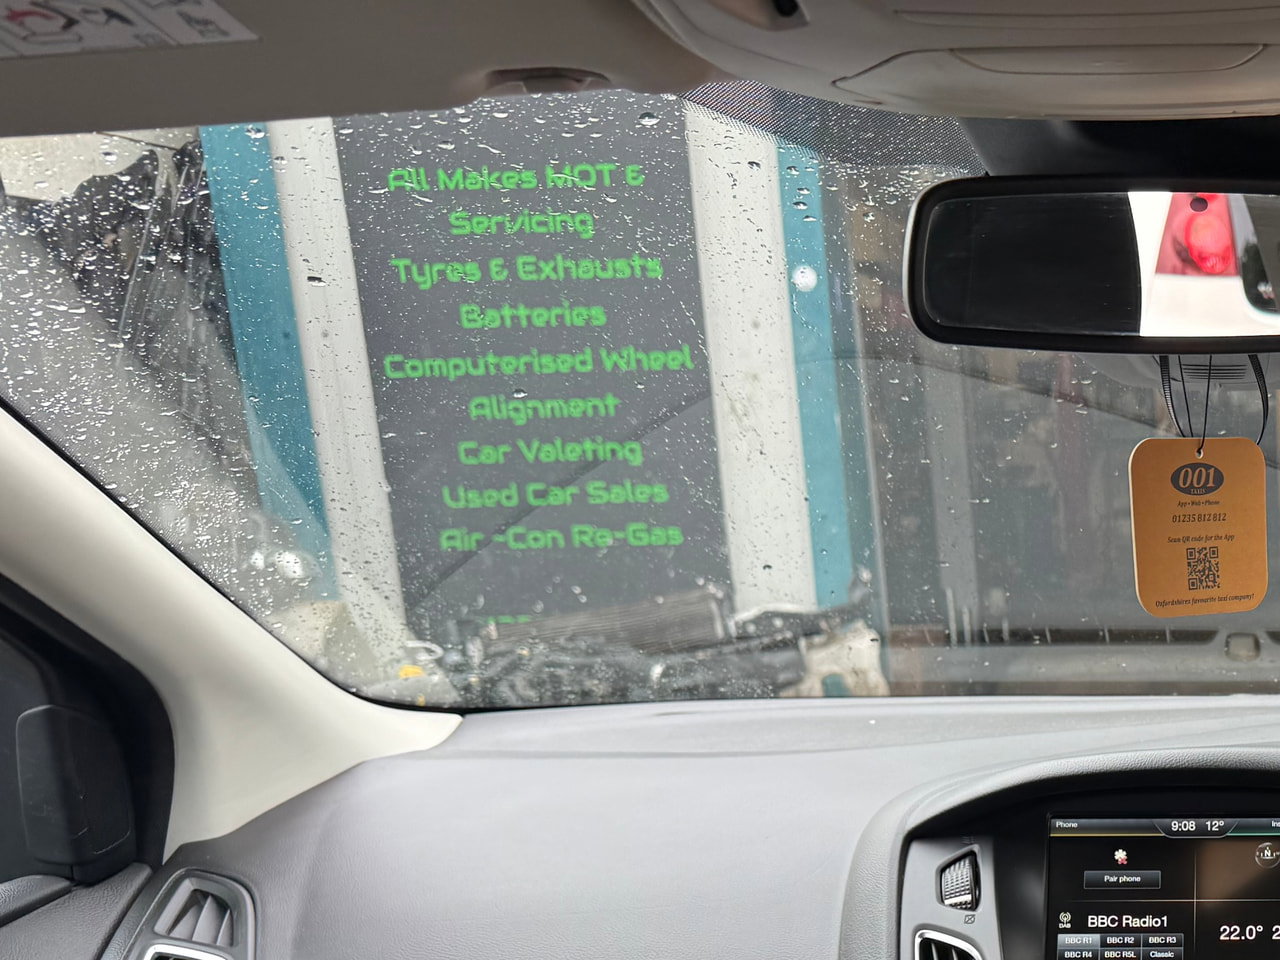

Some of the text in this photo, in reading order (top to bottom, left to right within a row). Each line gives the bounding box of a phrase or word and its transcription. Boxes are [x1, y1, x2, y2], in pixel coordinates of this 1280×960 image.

[387, 167, 430, 192] All
[436, 165, 538, 191] Makes
[545, 162, 617, 188] MOT
[448, 207, 595, 240] Servicing
[390, 257, 482, 291] Tyres
[516, 253, 664, 281] Exhausts
[459, 301, 607, 329] Batteries
[384, 344, 695, 381] Computerised Wheel
[468, 394, 621, 427] Alignment
[458, 437, 644, 467] Car Valeting
[1179, 467, 1215, 488] 001
[442, 480, 670, 509] Used Car Sales
[1172, 513, 1227, 523] 01235 812 812
[571, 522, 684, 548] Re-Gas
[1171, 820, 1196, 831] 9:08
[1119, 875, 1141, 883] phone
[1087, 915, 1168, 928] BBC Radio1
[1219, 925, 1263, 941] 22.0°
